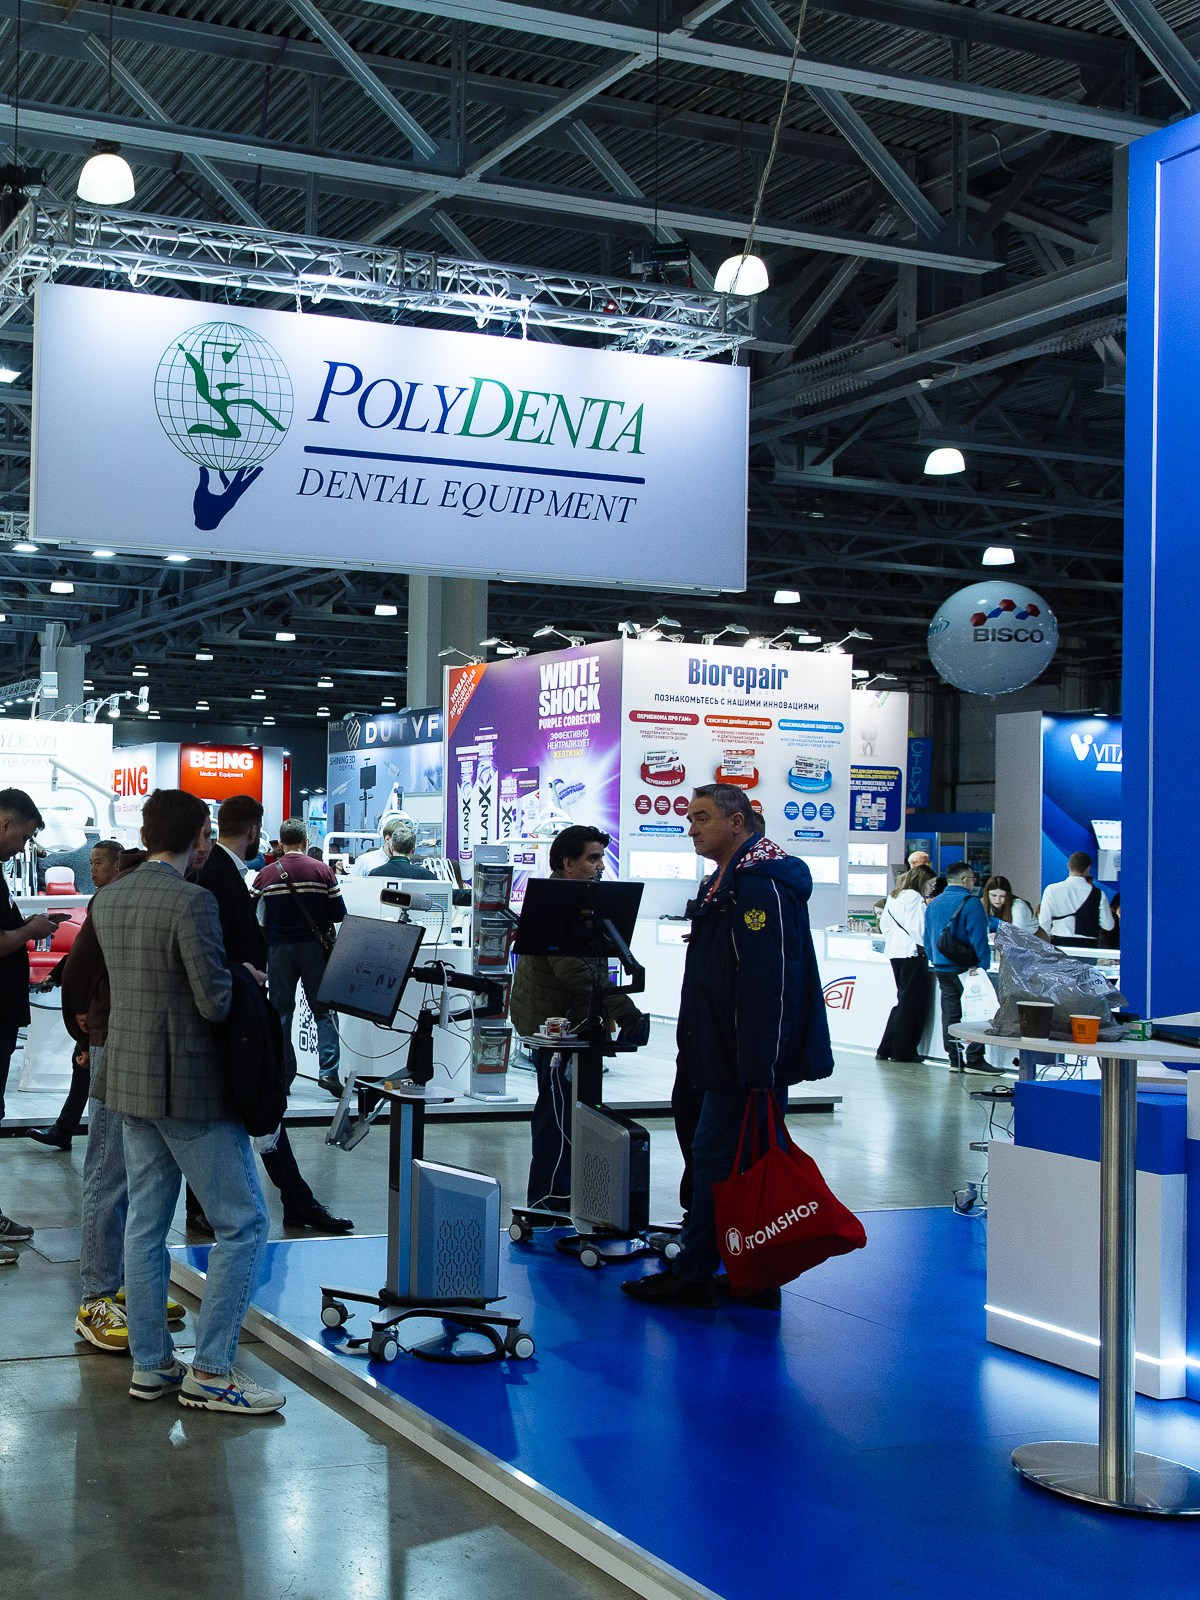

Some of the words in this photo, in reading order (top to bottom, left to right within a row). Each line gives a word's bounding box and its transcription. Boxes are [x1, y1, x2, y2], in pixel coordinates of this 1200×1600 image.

[297, 467, 430, 506] DENTAL
[438, 479, 638, 525] EQUIPMENT
[973, 627, 1044, 643] BISCO
[540, 656, 600, 691] WHITE
[688, 657, 788, 694] Biorepair
[538, 684, 600, 717] SHOCK
[654, 693, 719, 705] ПОЗНАКОМЬТЕСЬ
[727, 698, 761, 708] НАШИМИ
[763, 699, 820, 711] ИННОВАЦИЯМИ
[538, 717, 562, 730] PURPLE
[563, 712, 600, 727] CORRECTOR
[547, 738, 591, 750] НЕЙТРАЛИЗУЕТ
[550, 729, 589, 741] ЭФФЕКТИВНО
[190, 751, 254, 770] BEING
[111, 766, 148, 797] EING
[219, 771, 244, 779] Equipment
[745, 1201, 819, 1250] STOMSHOP
